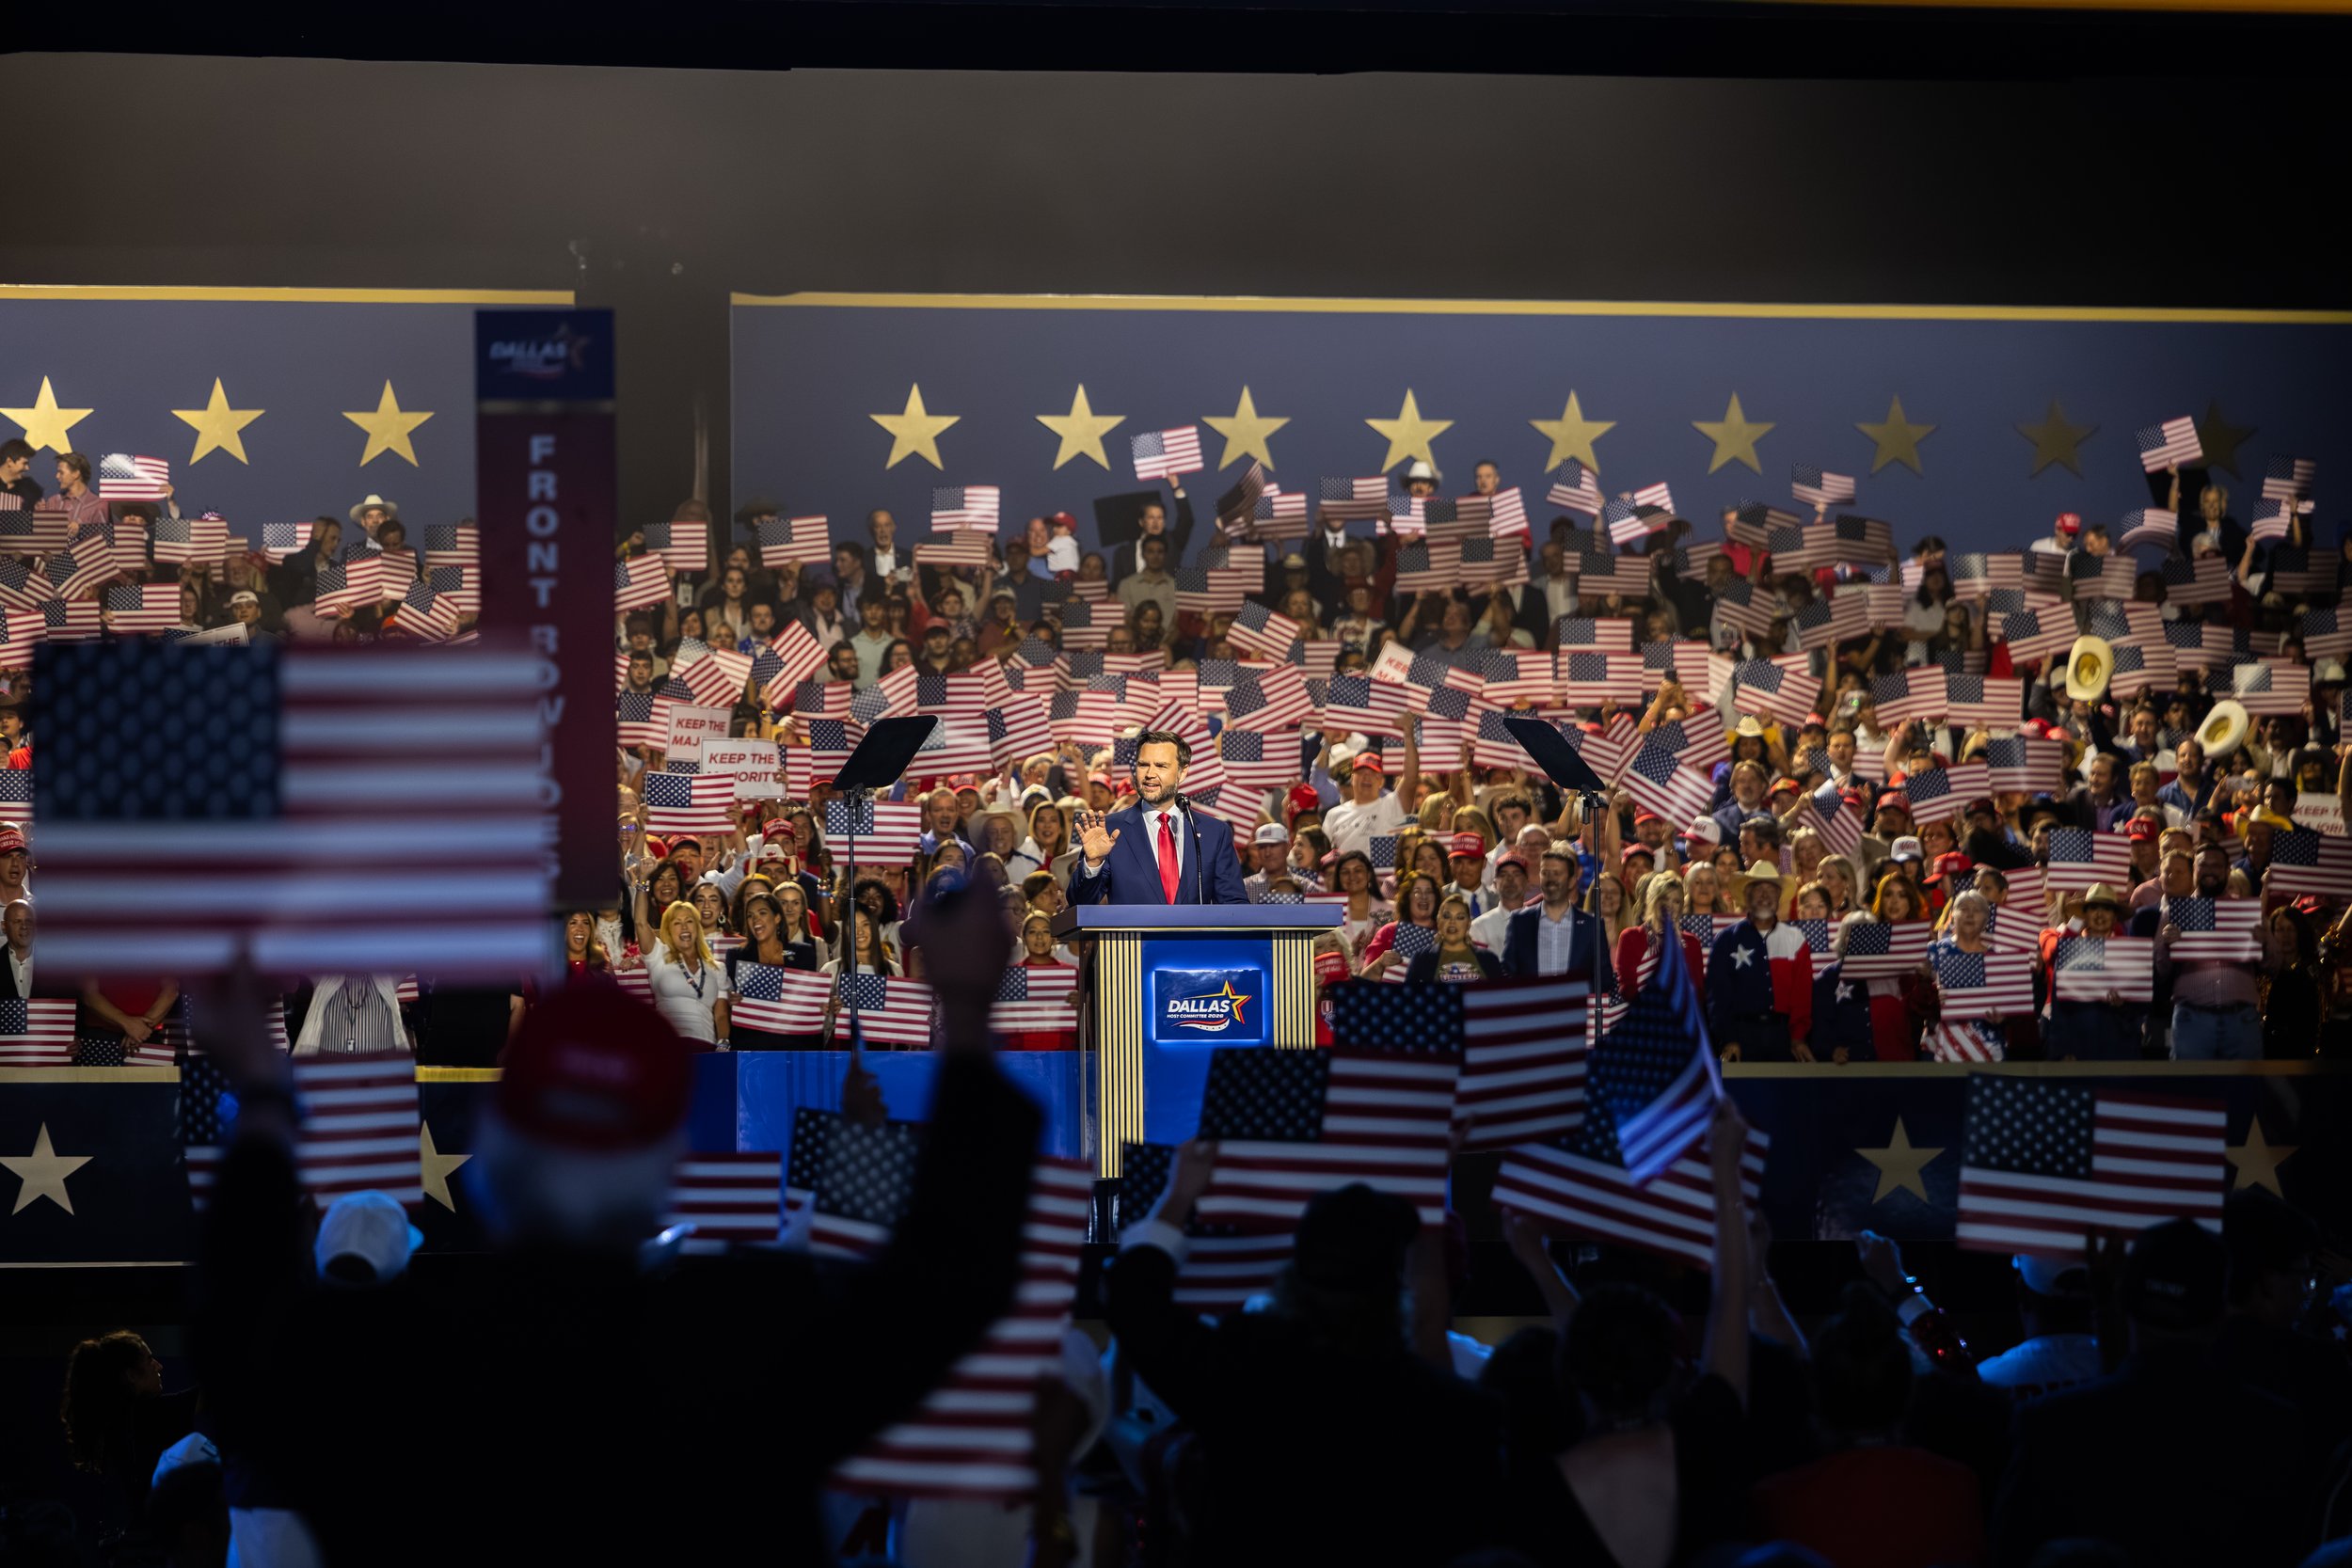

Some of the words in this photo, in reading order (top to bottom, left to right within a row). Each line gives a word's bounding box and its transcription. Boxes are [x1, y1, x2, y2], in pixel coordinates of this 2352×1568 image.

[488, 340, 568, 360] DALLAS
[527, 435, 559, 609] FRONT
[1385, 657, 1409, 674] KEE
[675, 718, 706, 730] KEEP
[708, 720, 726, 733] THE
[708, 752, 746, 765] KEEP
[750, 752, 775, 765] THE
[2294, 805, 2328, 816] KEEP
[1168, 999, 1231, 1013] DALLAS
